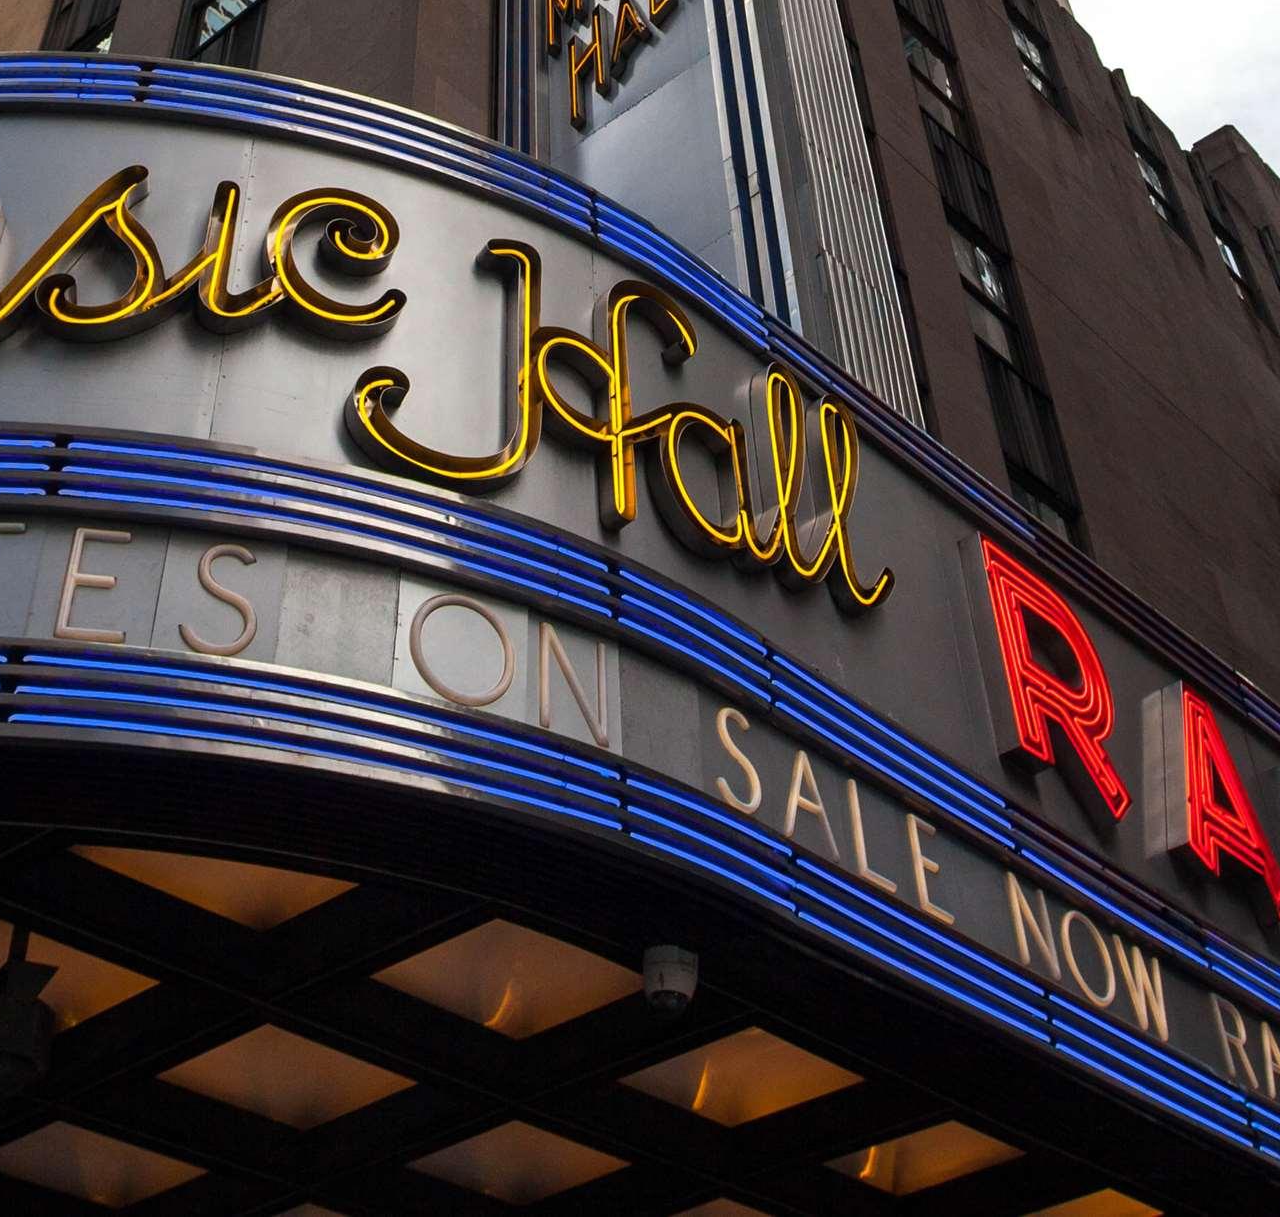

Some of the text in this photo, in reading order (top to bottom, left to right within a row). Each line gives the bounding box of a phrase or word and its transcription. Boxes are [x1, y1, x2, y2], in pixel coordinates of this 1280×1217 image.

[345, 239, 895, 615] Hall
[410, 593, 611, 749] ON
[716, 707, 956, 925] SALE
[1006, 871, 1170, 1043] NOW
